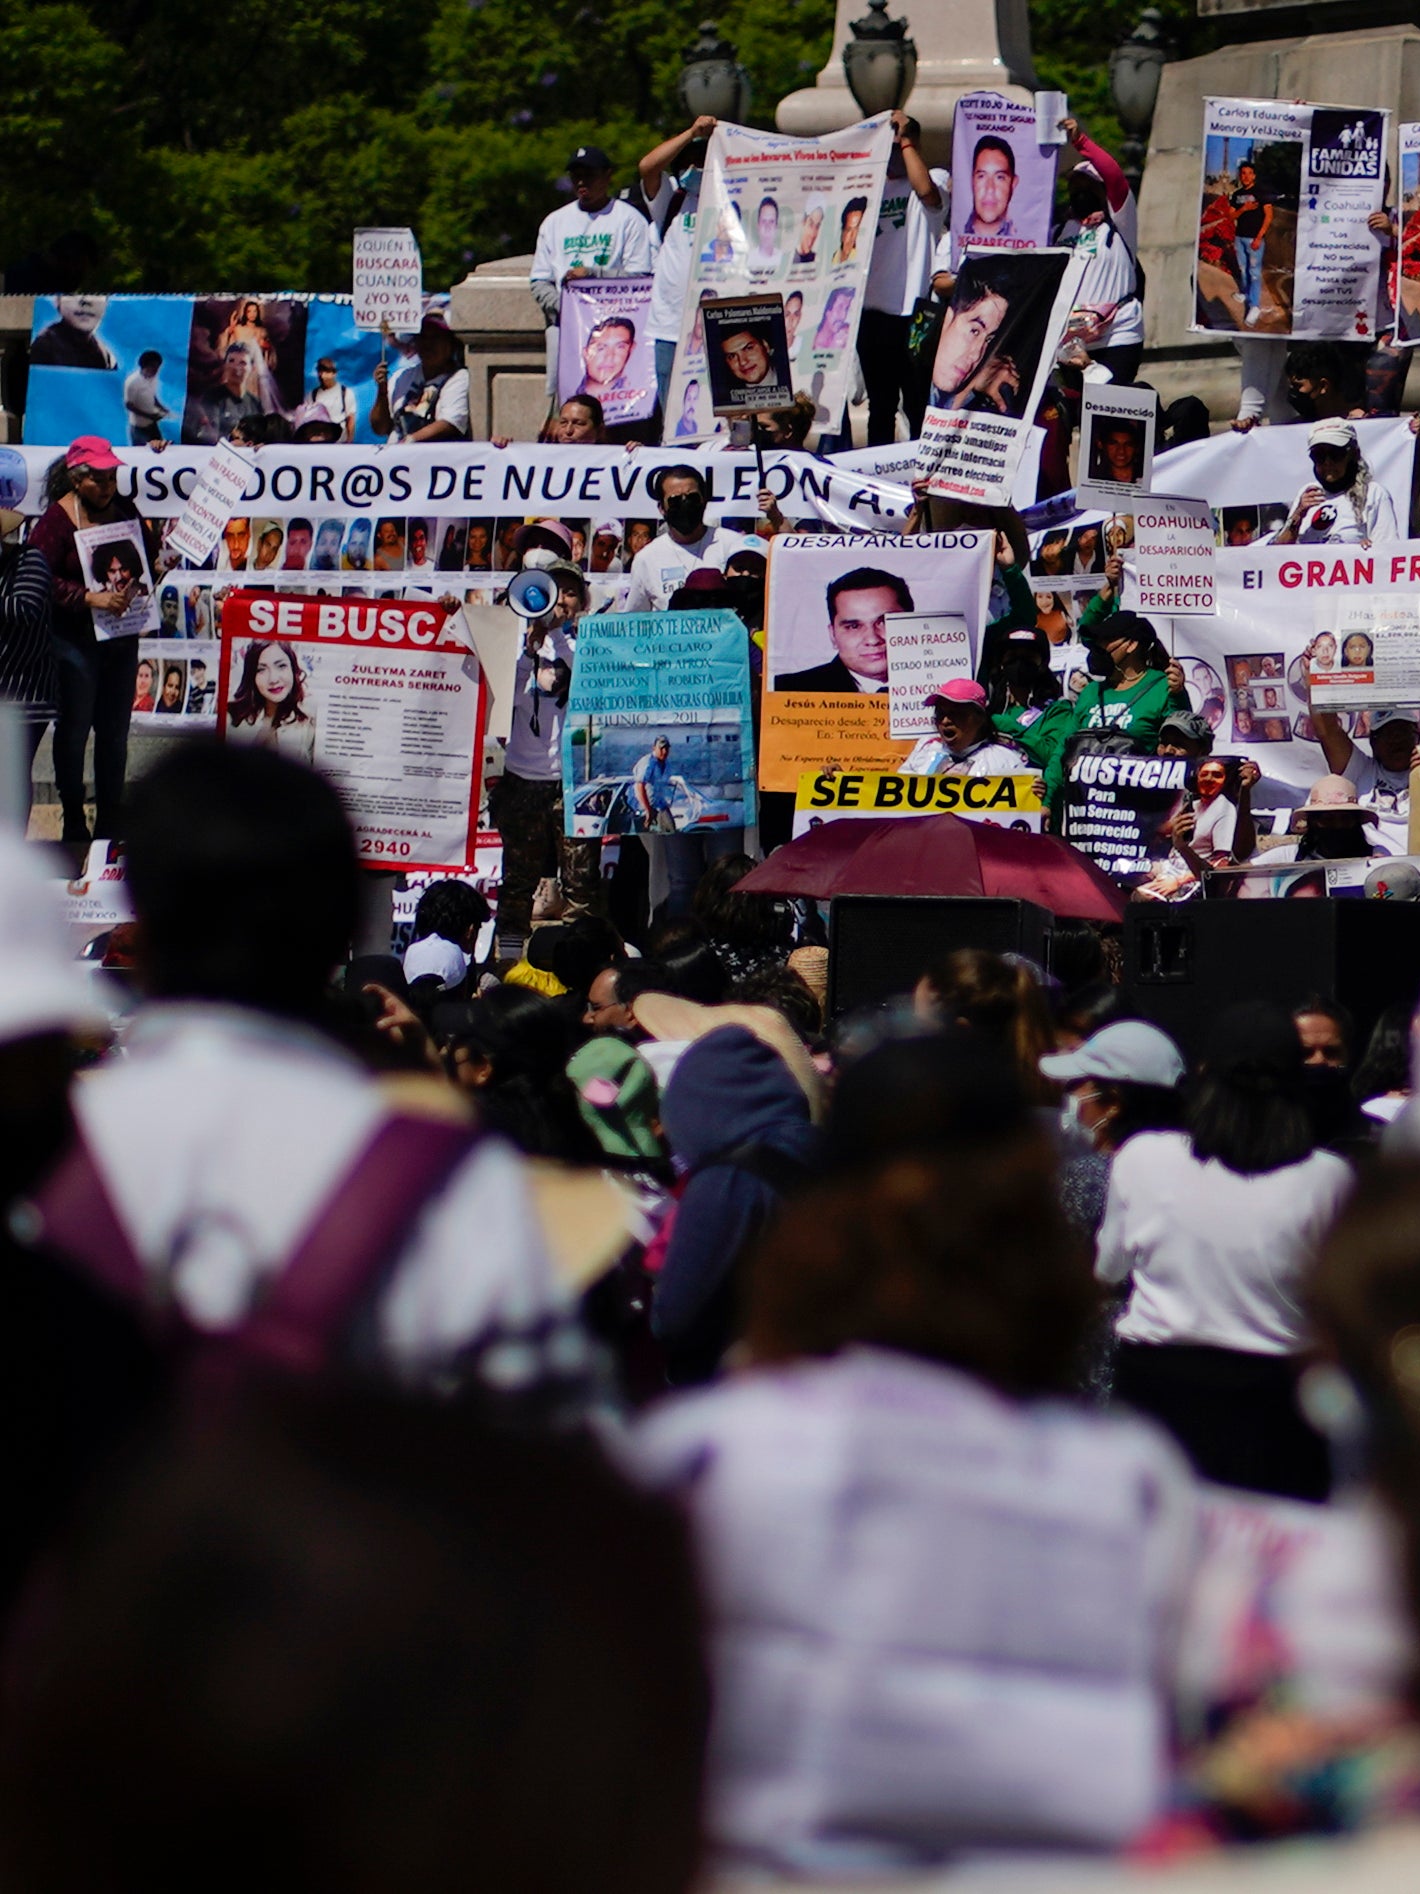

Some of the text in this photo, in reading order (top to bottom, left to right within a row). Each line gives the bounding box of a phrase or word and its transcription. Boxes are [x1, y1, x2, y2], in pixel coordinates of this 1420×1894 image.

[1219, 107, 1296, 122] Carlos Eduardo
[1210, 122, 1302, 138] Monroy Velázquez
[1312, 149, 1378, 161] FAMILIAS
[1311, 160, 1378, 176] UNIDAS
[1323, 200, 1372, 210] Coahuila
[357, 256, 418, 269] BUSCARÁ
[356, 274, 418, 287] CUANDO
[365, 293, 409, 304] ¿YO YA
[356, 309, 418, 323] NO ESTÉ?
[1086, 402, 1154, 418] Desaparecido
[116, 464, 412, 507] USCDOR@S
[428, 465, 487, 501] DE
[703, 455, 832, 502] LEÓN
[1138, 515, 1210, 529] COAHUILA
[783, 533, 978, 549] DESAPARECIDO
[1140, 545, 1212, 556] DESAPARICIÓN
[1140, 575, 1213, 587] EL CRIMEN
[1243, 570, 1262, 589] El
[1278, 558, 1374, 589] GRAN
[1141, 593, 1213, 607] PERFECTO
[249, 599, 465, 647] SE BUSCA
[890, 632, 966, 647] GRAN FRACASO
[580, 646, 612, 657] OJOS
[669, 642, 712, 652] CLARO
[352, 664, 447, 680] ZULEYMA ZARET
[891, 658, 968, 671] ESTADO MEXICANO
[334, 676, 461, 693] CONTRERAS SERRANO
[892, 686, 906, 696] NO
[1069, 755, 1186, 789] JUSTICIA
[810, 775, 1017, 808] SE BUSCA
[1088, 788, 1116, 802] Para
[1088, 804, 1136, 821] Serrano
[361, 839, 410, 856] 2940
[1094, 842, 1147, 858] esposa y
